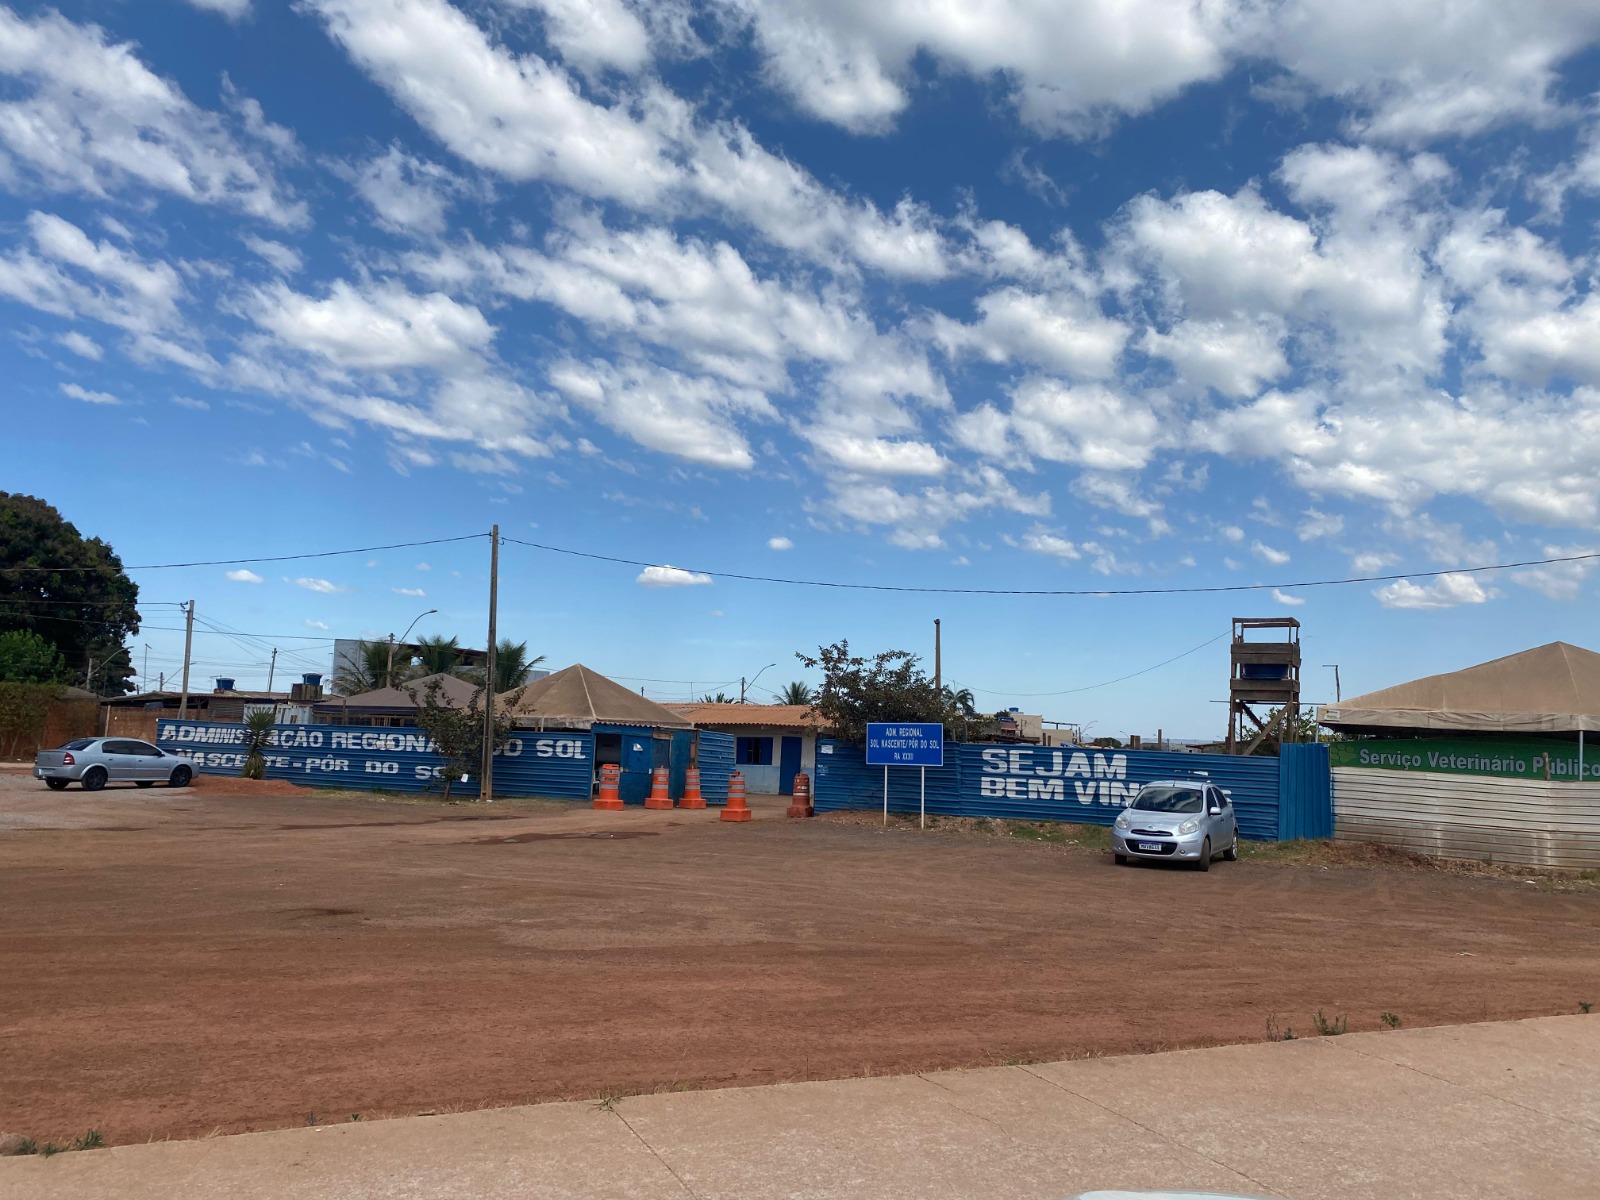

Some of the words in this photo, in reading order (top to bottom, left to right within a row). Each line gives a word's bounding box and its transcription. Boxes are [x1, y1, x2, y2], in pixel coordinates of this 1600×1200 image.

[160, 725, 323, 749] ADMINISAÇÃO
[332, 732, 455, 753] REGIONA
[536, 739, 586, 759] SOL
[870, 739, 879, 748] SOL
[920, 740, 927, 749] DO
[930, 740, 940, 749] SOL
[899, 728, 923, 737] REGIONAL
[365, 760, 399, 774] DO
[414, 765, 450, 780] SO
[981, 748, 1127, 780] SEJAM
[1359, 748, 1422, 771] Serviço
[1426, 751, 1526, 773] Veterinário
[980, 776, 1064, 801] BEM
